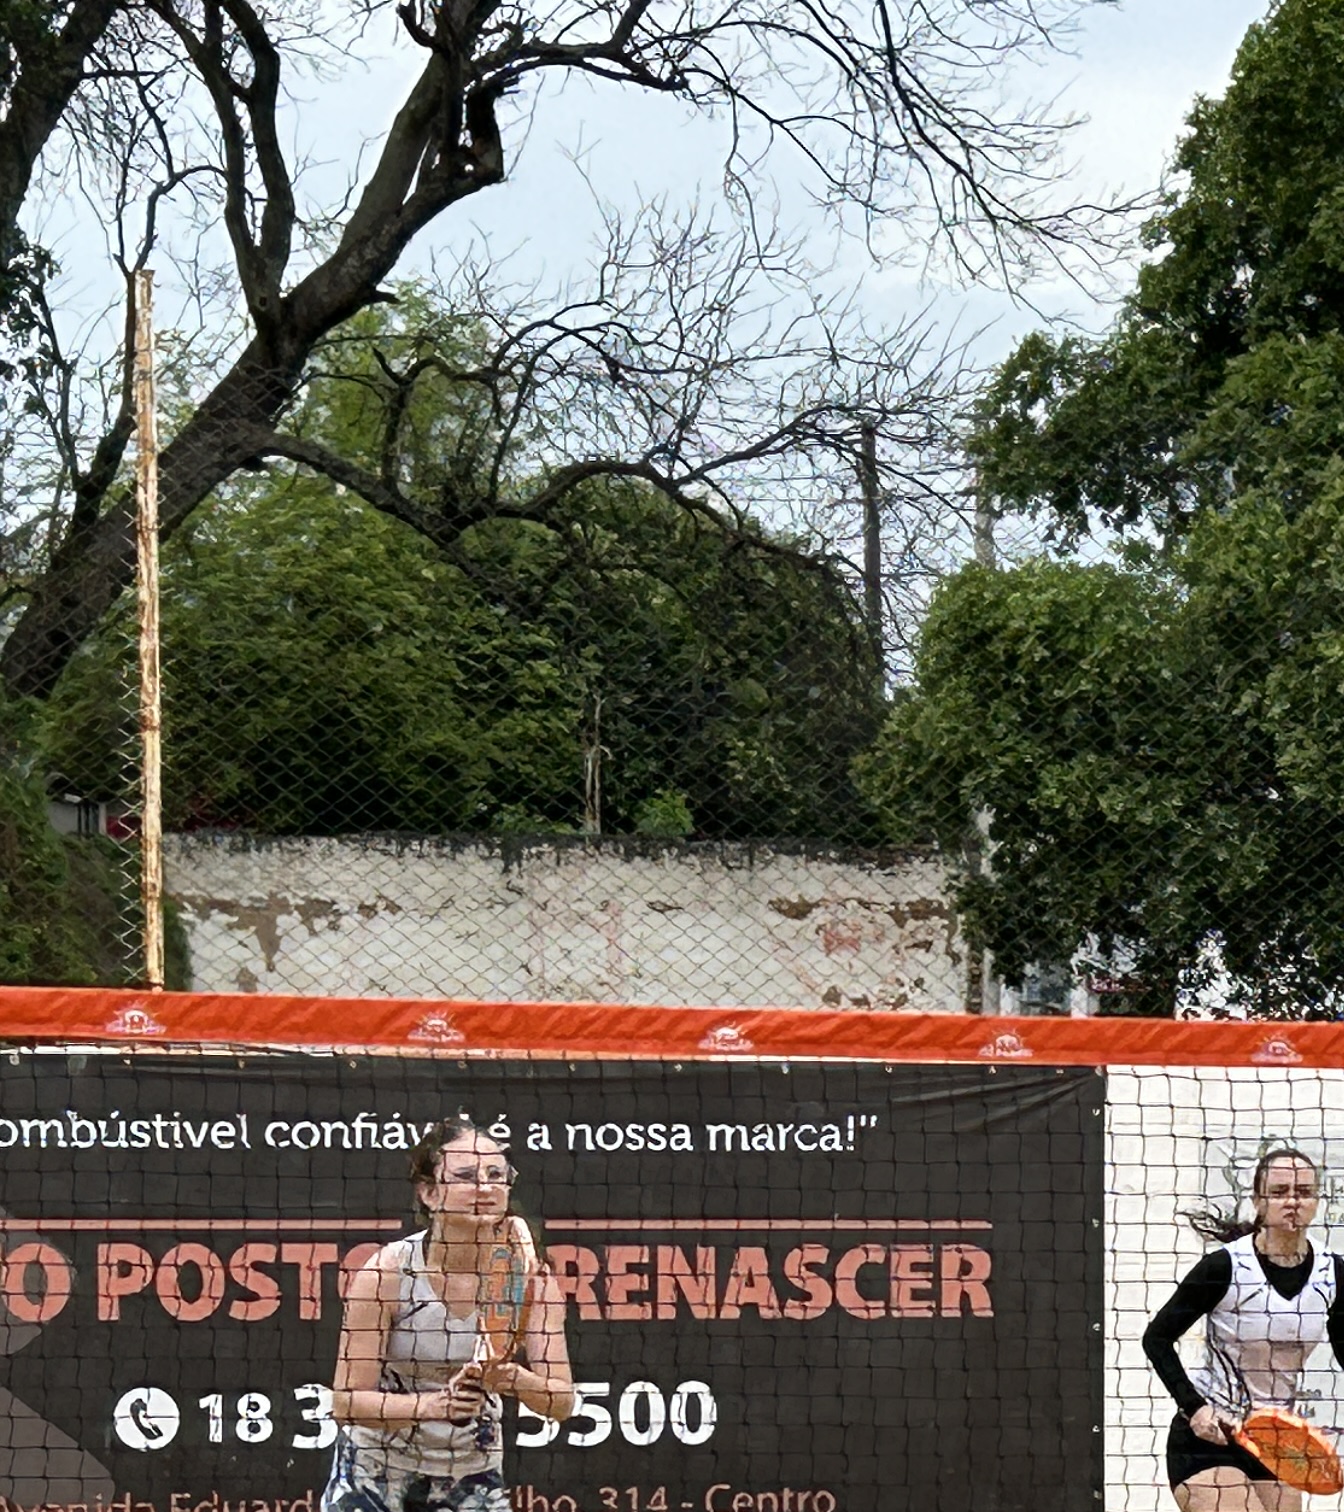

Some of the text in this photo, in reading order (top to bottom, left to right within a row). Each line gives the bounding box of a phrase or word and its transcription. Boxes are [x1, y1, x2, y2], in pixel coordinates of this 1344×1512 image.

[264, 1112, 436, 1149] confiáv
[526, 1122, 553, 1151] a
[566, 1121, 693, 1151] nossa
[97, 1243, 374, 1322] POST
[545, 1243, 994, 1321] RENASCER
[199, 1393, 274, 1444] 18
